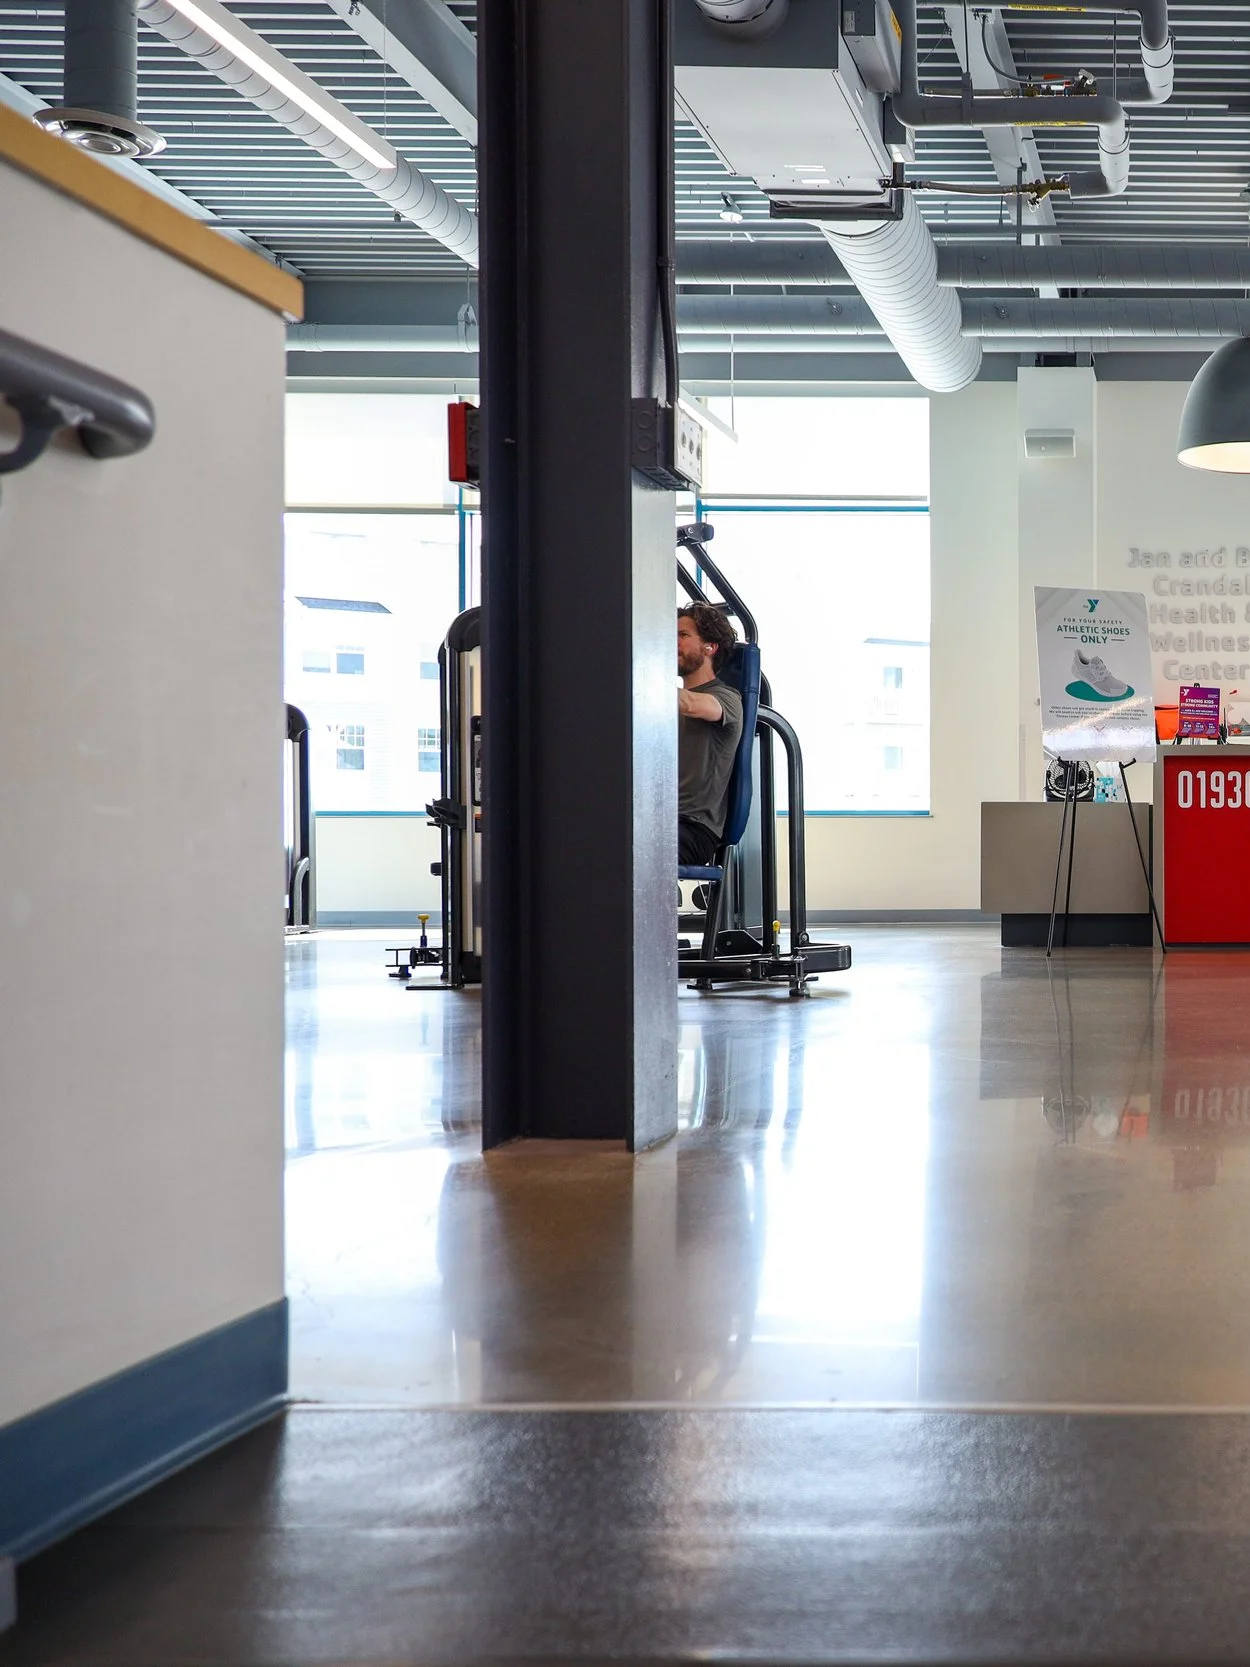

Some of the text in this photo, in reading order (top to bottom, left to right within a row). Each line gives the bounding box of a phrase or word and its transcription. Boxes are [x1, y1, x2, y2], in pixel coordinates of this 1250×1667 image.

[1127, 547, 1172, 568] Jan
[1179, 546, 1226, 568] and
[1149, 602, 1236, 625] Health
[1056, 624, 1130, 636] ATHLETIC SHOES
[1080, 635, 1108, 644] ONLY
